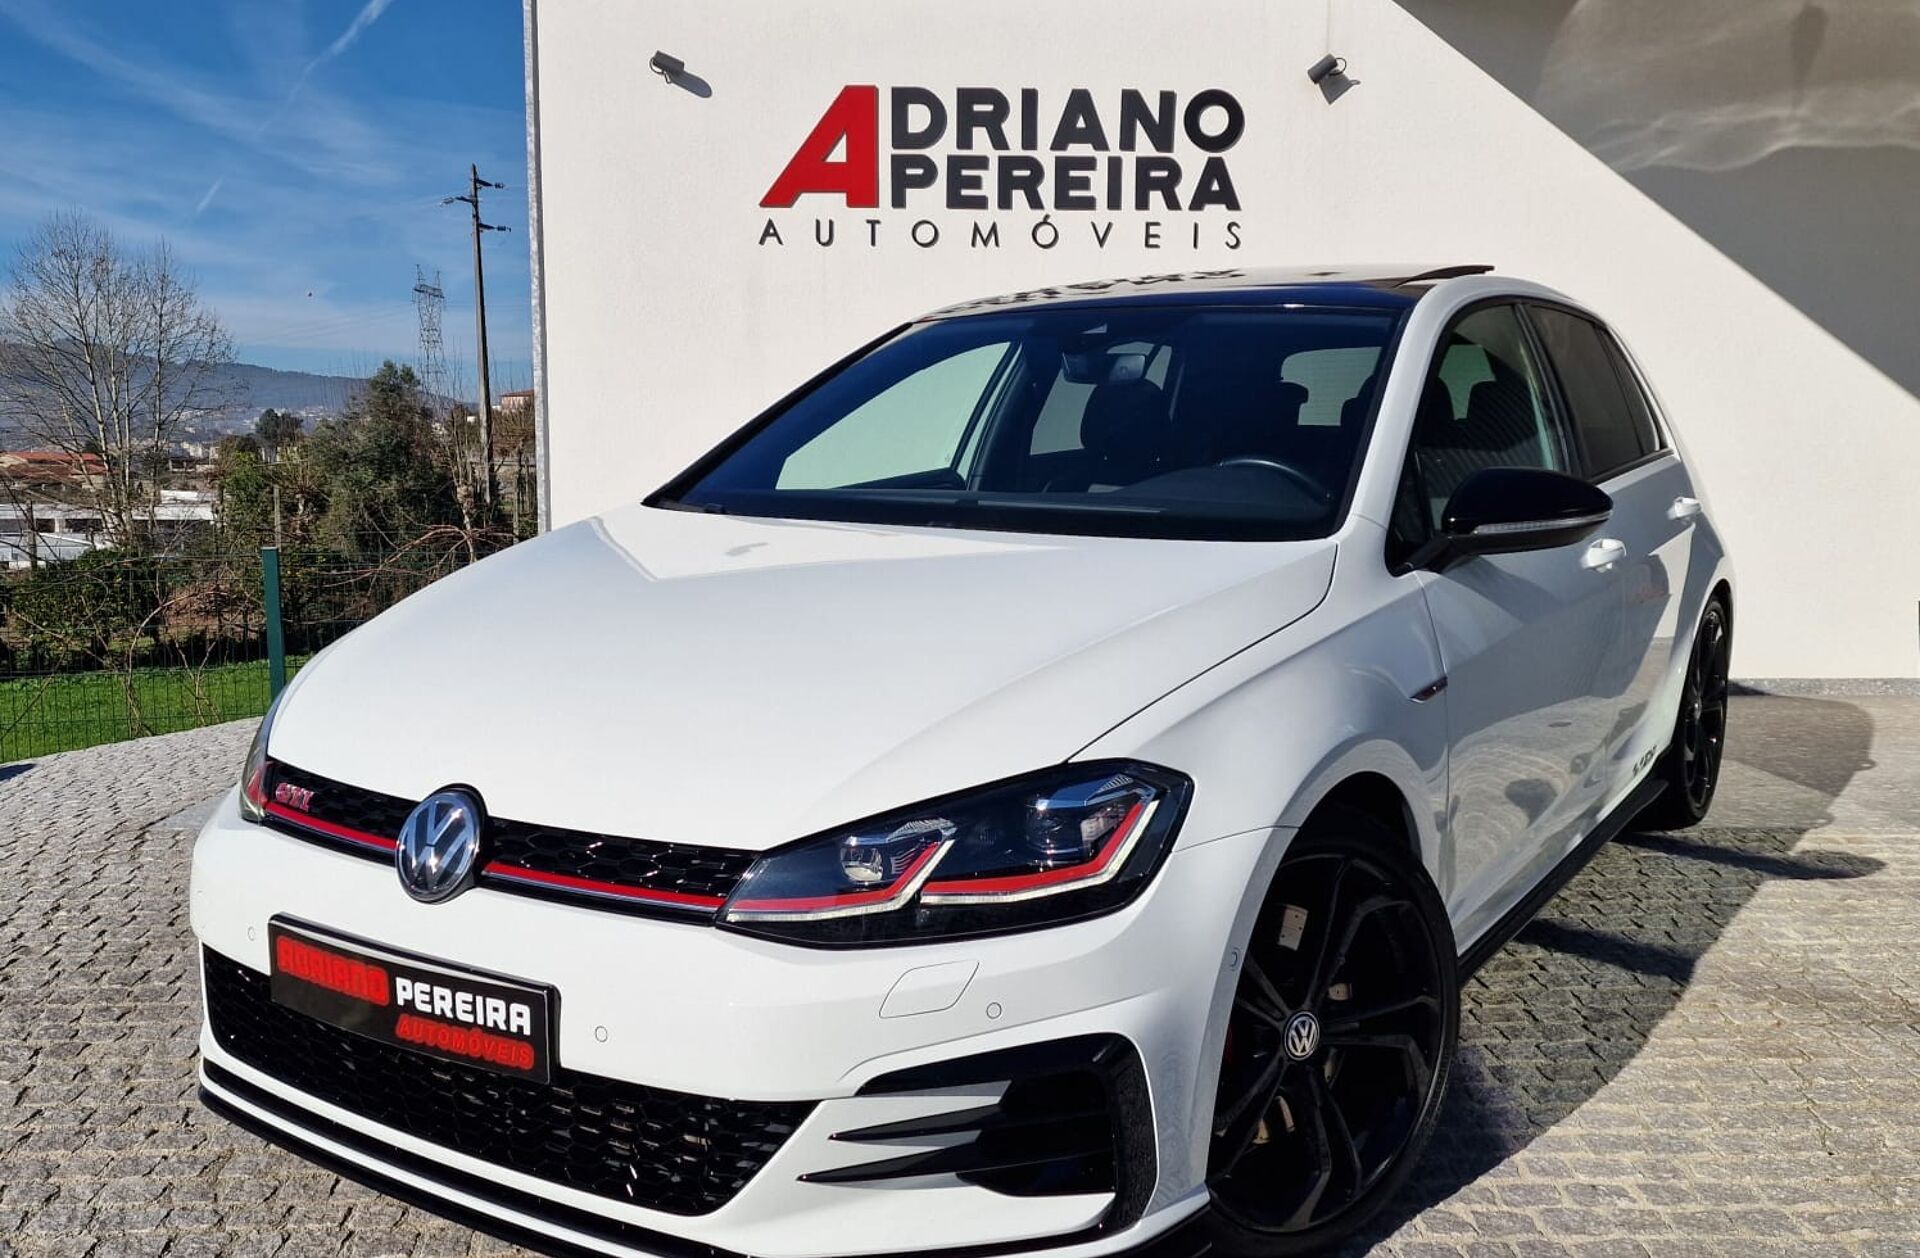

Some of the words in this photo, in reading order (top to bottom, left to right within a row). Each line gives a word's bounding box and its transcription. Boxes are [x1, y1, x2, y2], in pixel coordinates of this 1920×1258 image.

[758, 85, 1246, 208] ADRIANO
[890, 153, 1242, 212] PEREIRA
[758, 213, 1242, 250] AUTOMÓVEIS
[395, 976, 531, 1036] PEREIRA
[397, 1015, 533, 1069] AUTOMÓVEIS
